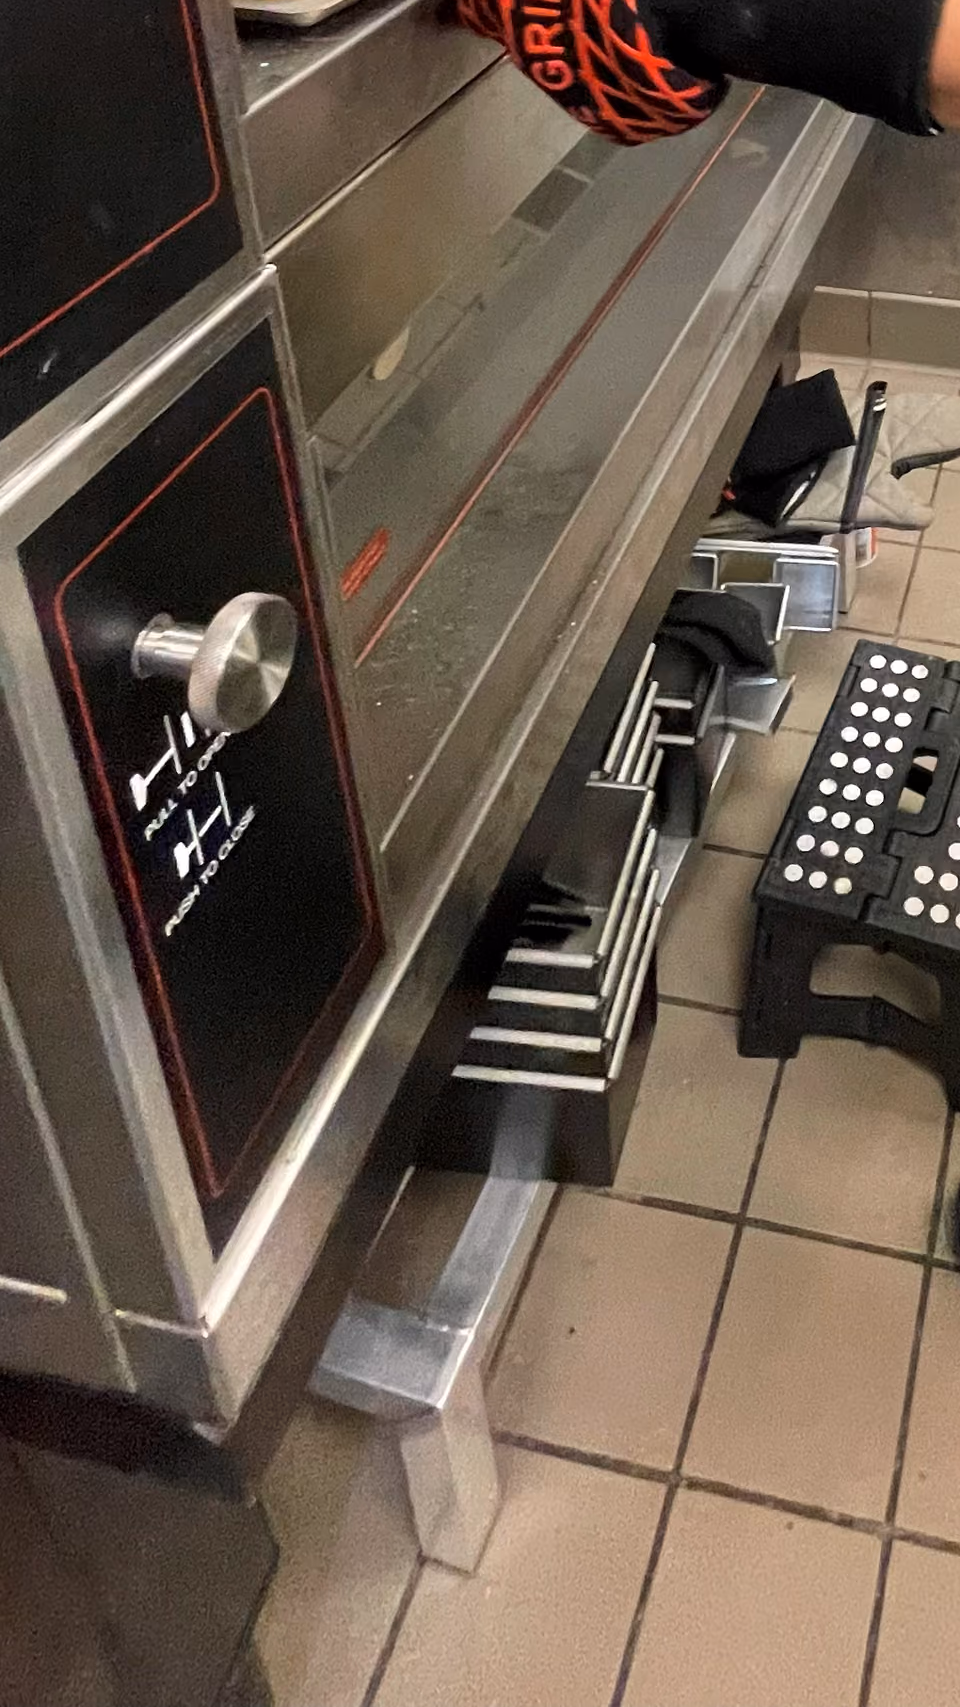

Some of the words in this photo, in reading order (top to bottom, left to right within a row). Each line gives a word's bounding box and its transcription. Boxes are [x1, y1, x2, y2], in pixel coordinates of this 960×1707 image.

[177, 770, 198, 795] TO
[200, 859, 219, 885] TO
[218, 805, 256, 861] CLOSE
